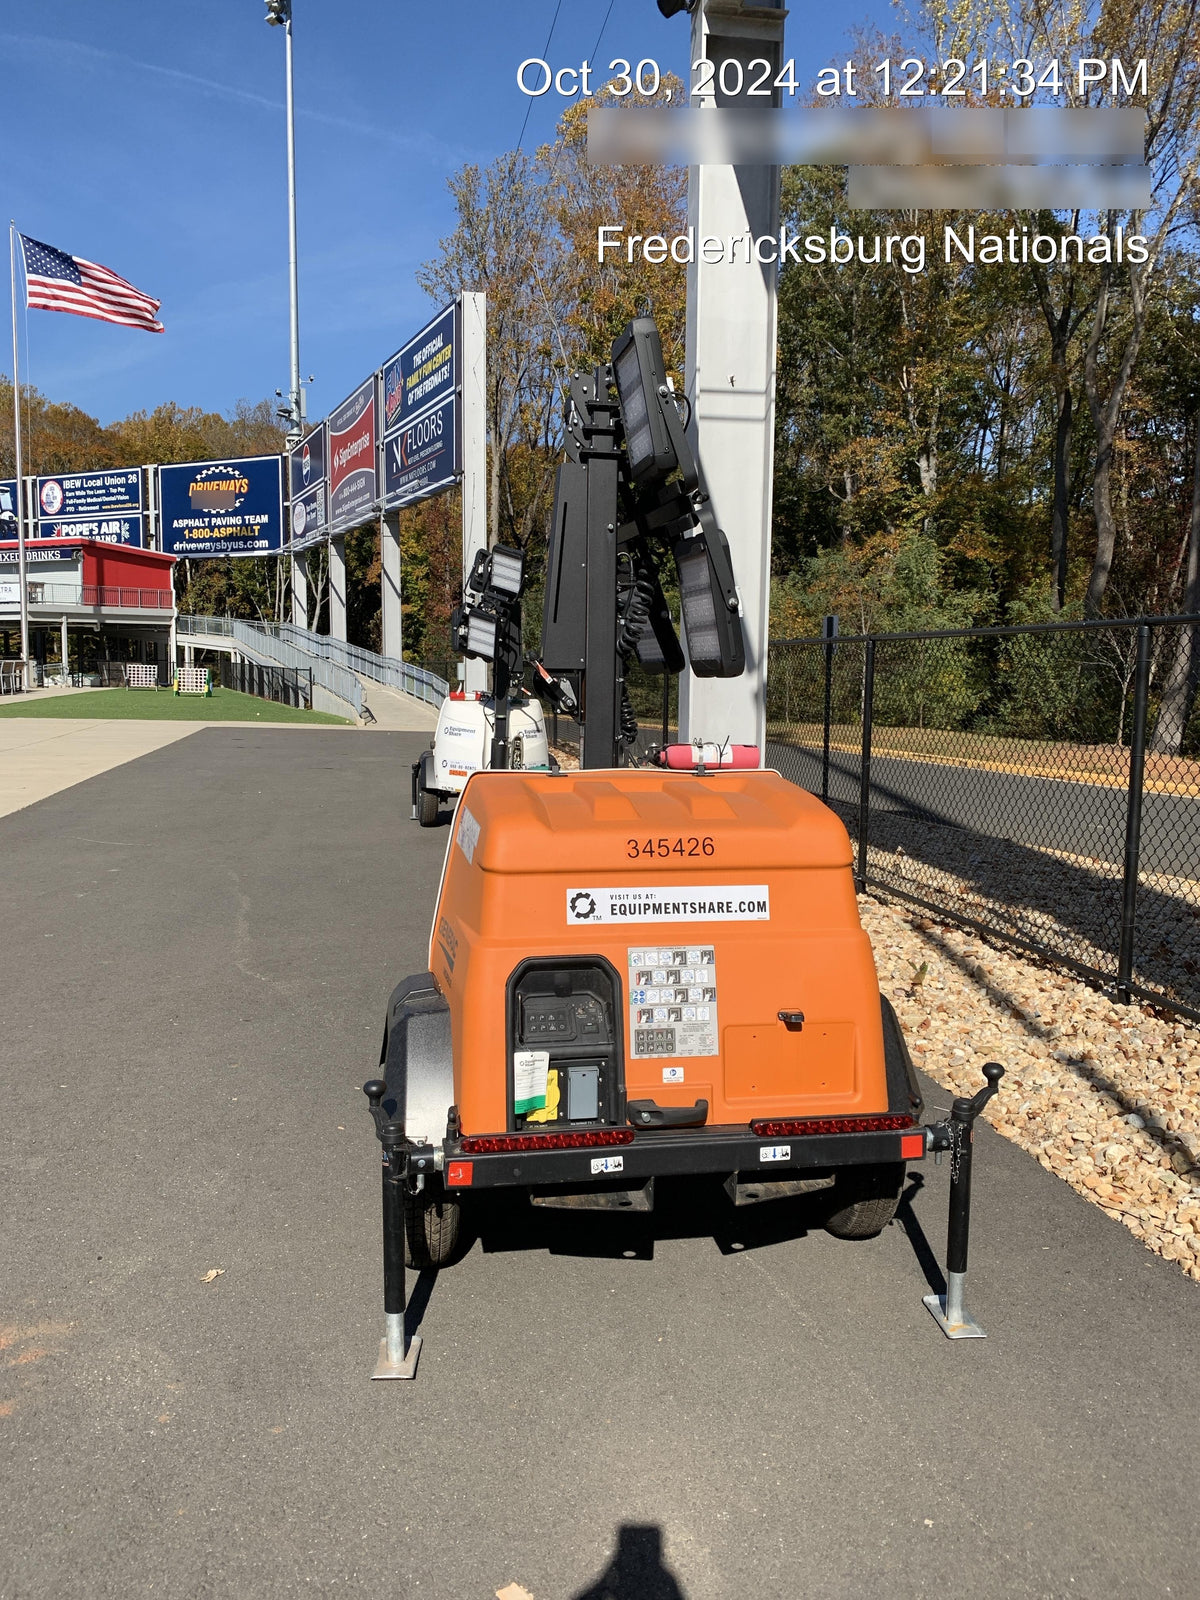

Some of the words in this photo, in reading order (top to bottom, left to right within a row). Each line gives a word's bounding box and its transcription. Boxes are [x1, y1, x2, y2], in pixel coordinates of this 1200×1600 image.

[413, 350, 422, 368] THE
[422, 332, 443, 361] OFFICIAL
[433, 344, 452, 370] CENTER
[408, 410, 443, 452] FLOORS
[340, 431, 370, 468] SignEnterprise
[63, 479, 82, 489] IBEW
[83, 477, 102, 487] Local
[104, 475, 126, 486] Union
[128, 474, 137, 484] 26
[62, 522, 98, 536] POPE'S
[100, 521, 120, 534] AIR
[172, 518, 209, 528] ASPHALT
[211, 516, 242, 526] PAVING
[244, 514, 268, 524] TEAM
[184, 525, 260, 539] 1-800-ASPHALT
[173, 540, 268, 552] drivewaysbyus.com
[26, 550, 61, 560] DRINKS
[626, 836, 715, 858] 345426
[610, 900, 767, 917] EQUIPMENTSHARE.COM
